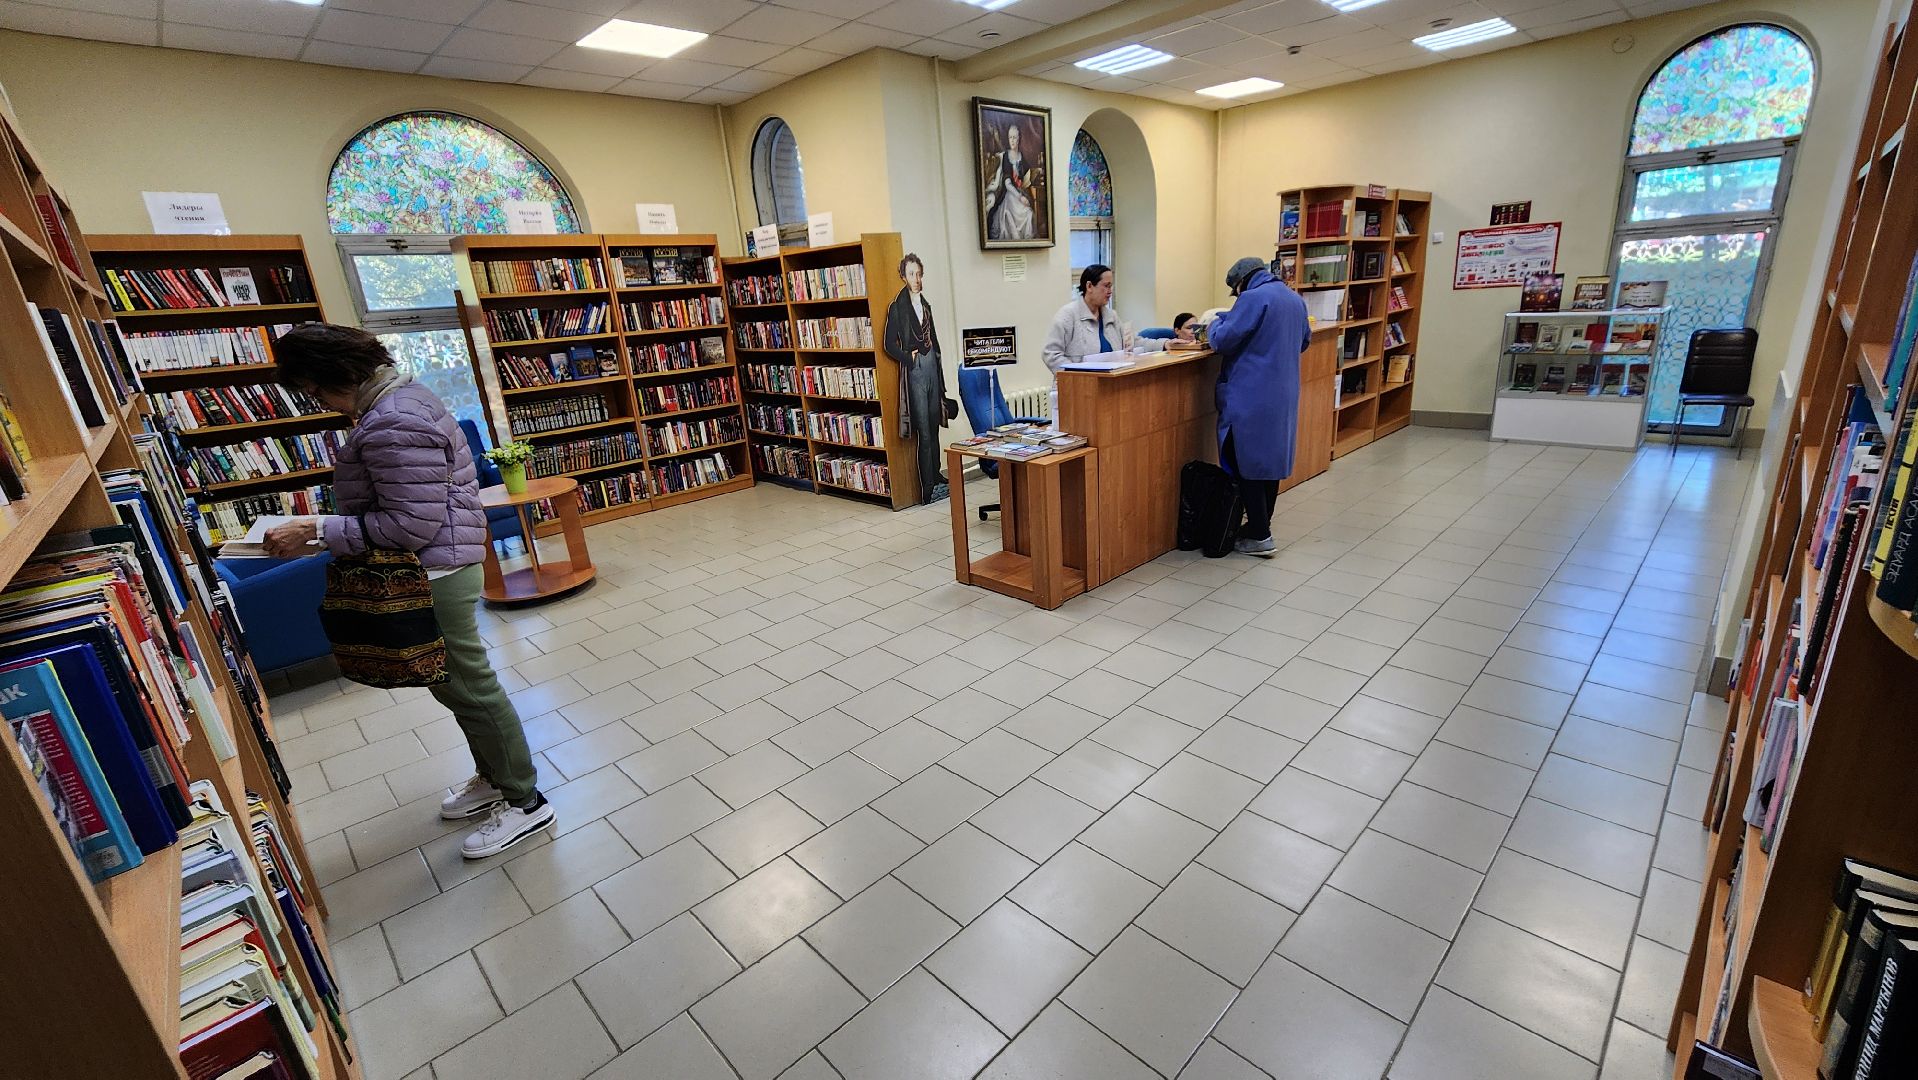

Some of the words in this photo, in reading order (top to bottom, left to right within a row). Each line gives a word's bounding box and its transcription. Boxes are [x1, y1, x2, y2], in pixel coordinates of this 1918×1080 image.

[169, 203, 204, 212] Лидеры
[232, 284, 251, 294] ИМЯ
[973, 338, 1005, 346] ЧИТАТЕЛИ
[1885, 531, 1912, 583] ЭДУАРД
[1868, 957, 1898, 1039] МАРТЫНОВ
